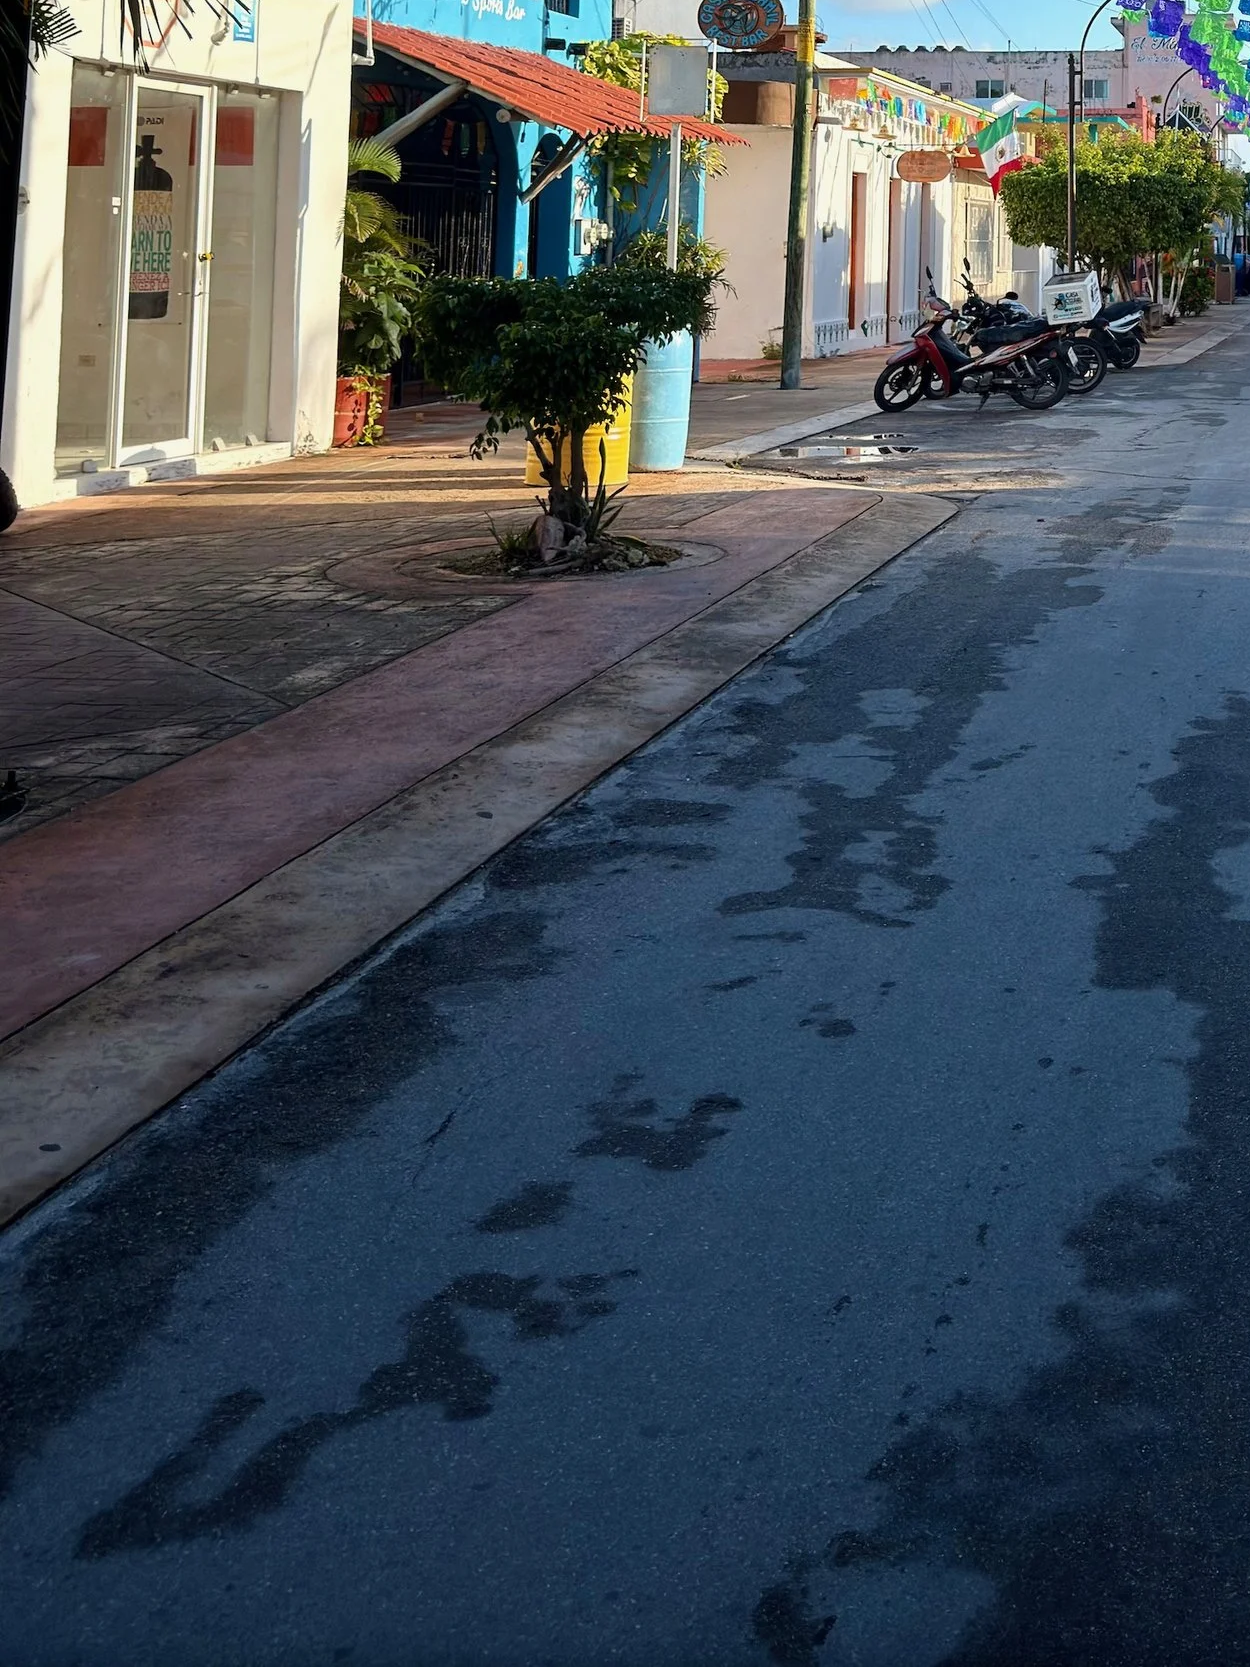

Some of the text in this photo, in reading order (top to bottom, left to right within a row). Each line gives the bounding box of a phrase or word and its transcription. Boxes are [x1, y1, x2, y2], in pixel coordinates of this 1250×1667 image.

[706, 24, 769, 47] REST BAR
[157, 231, 171, 251] TO
[143, 253, 171, 272] HERE
